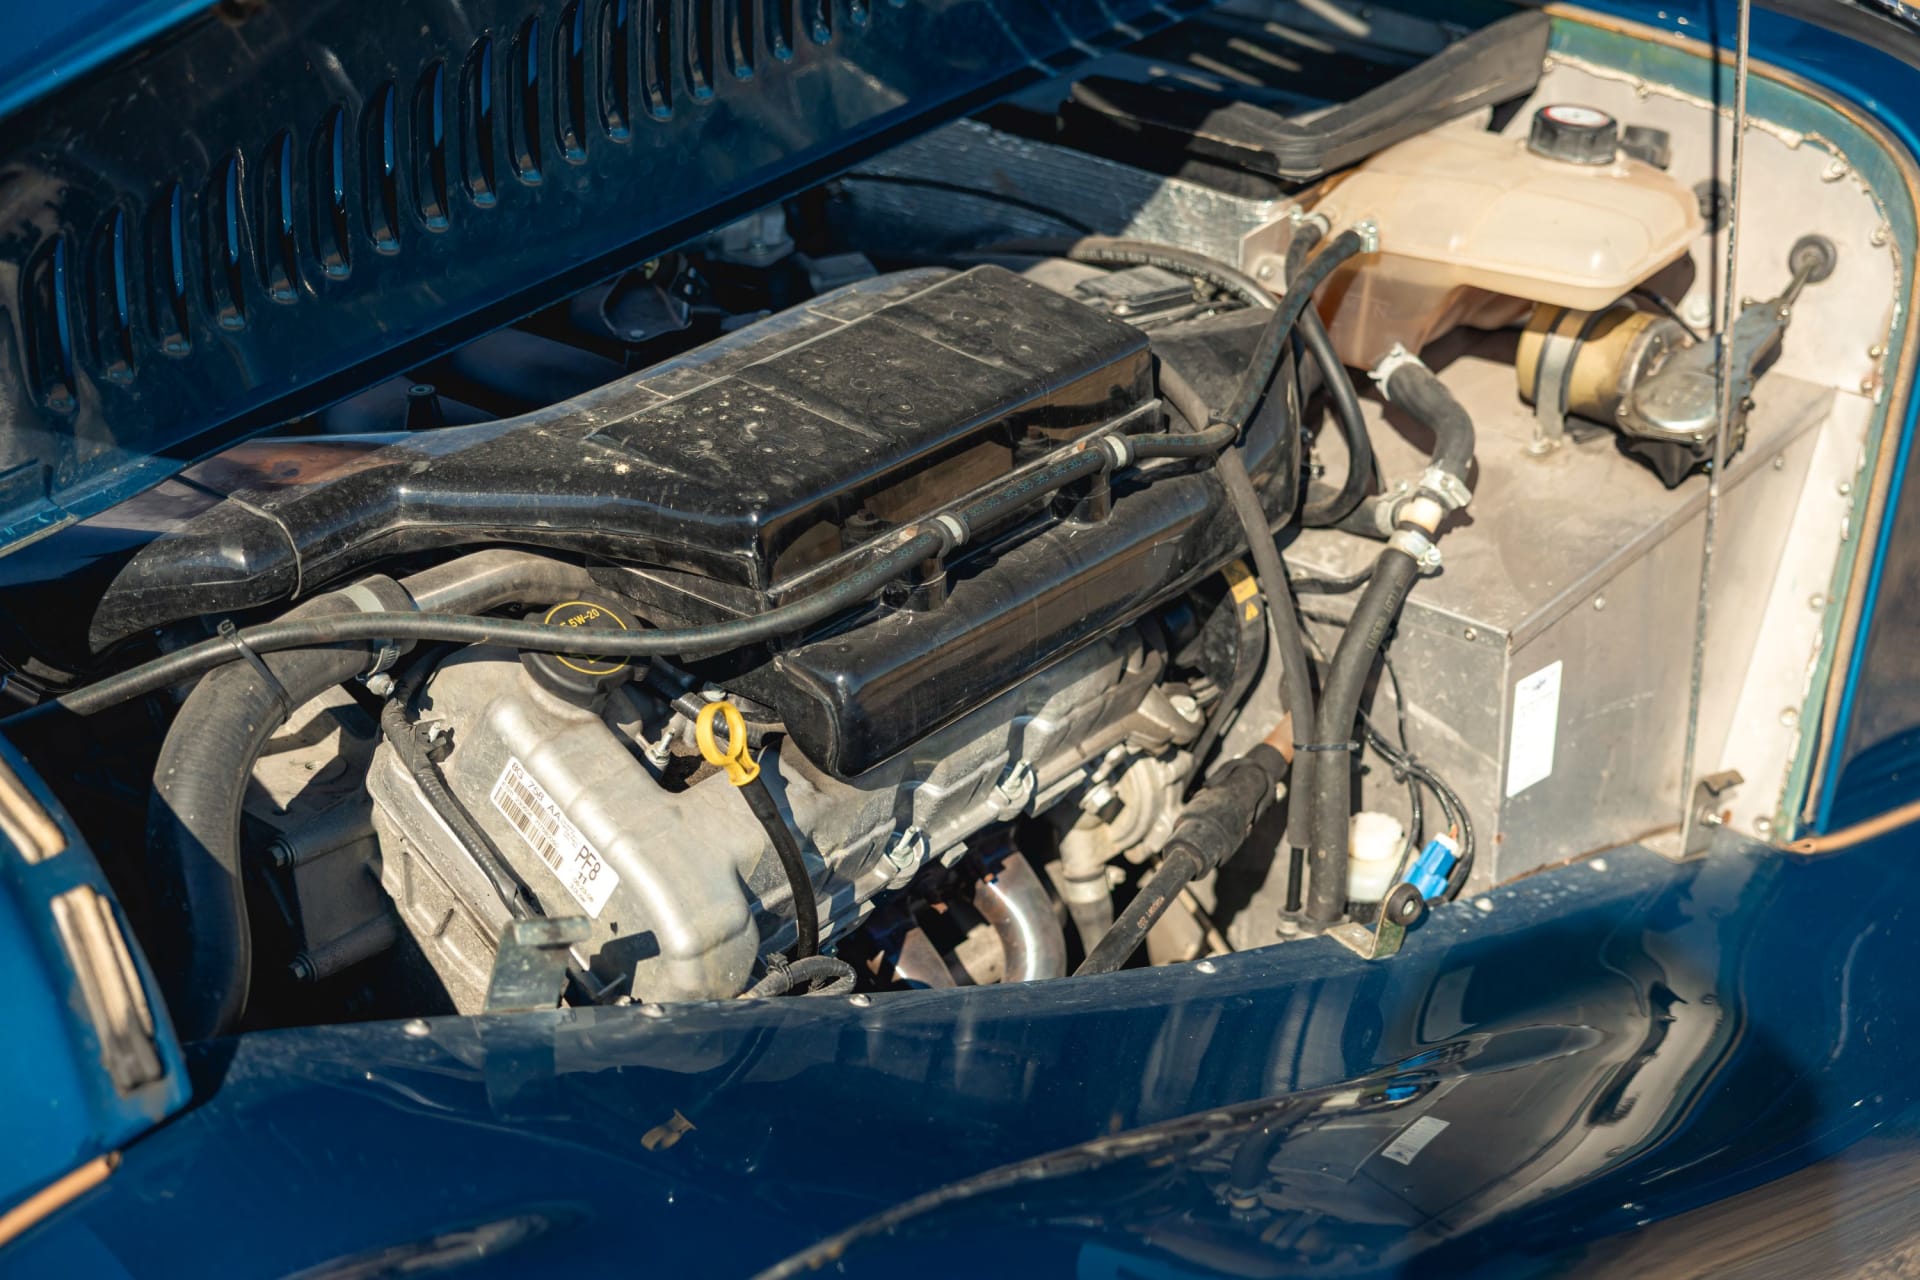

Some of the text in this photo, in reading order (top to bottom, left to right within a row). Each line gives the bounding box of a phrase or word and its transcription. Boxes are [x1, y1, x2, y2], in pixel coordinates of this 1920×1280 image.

[568, 609, 600, 627] 5W-20
[547, 804, 561, 822] AA
[574, 844, 601, 881] PF8
